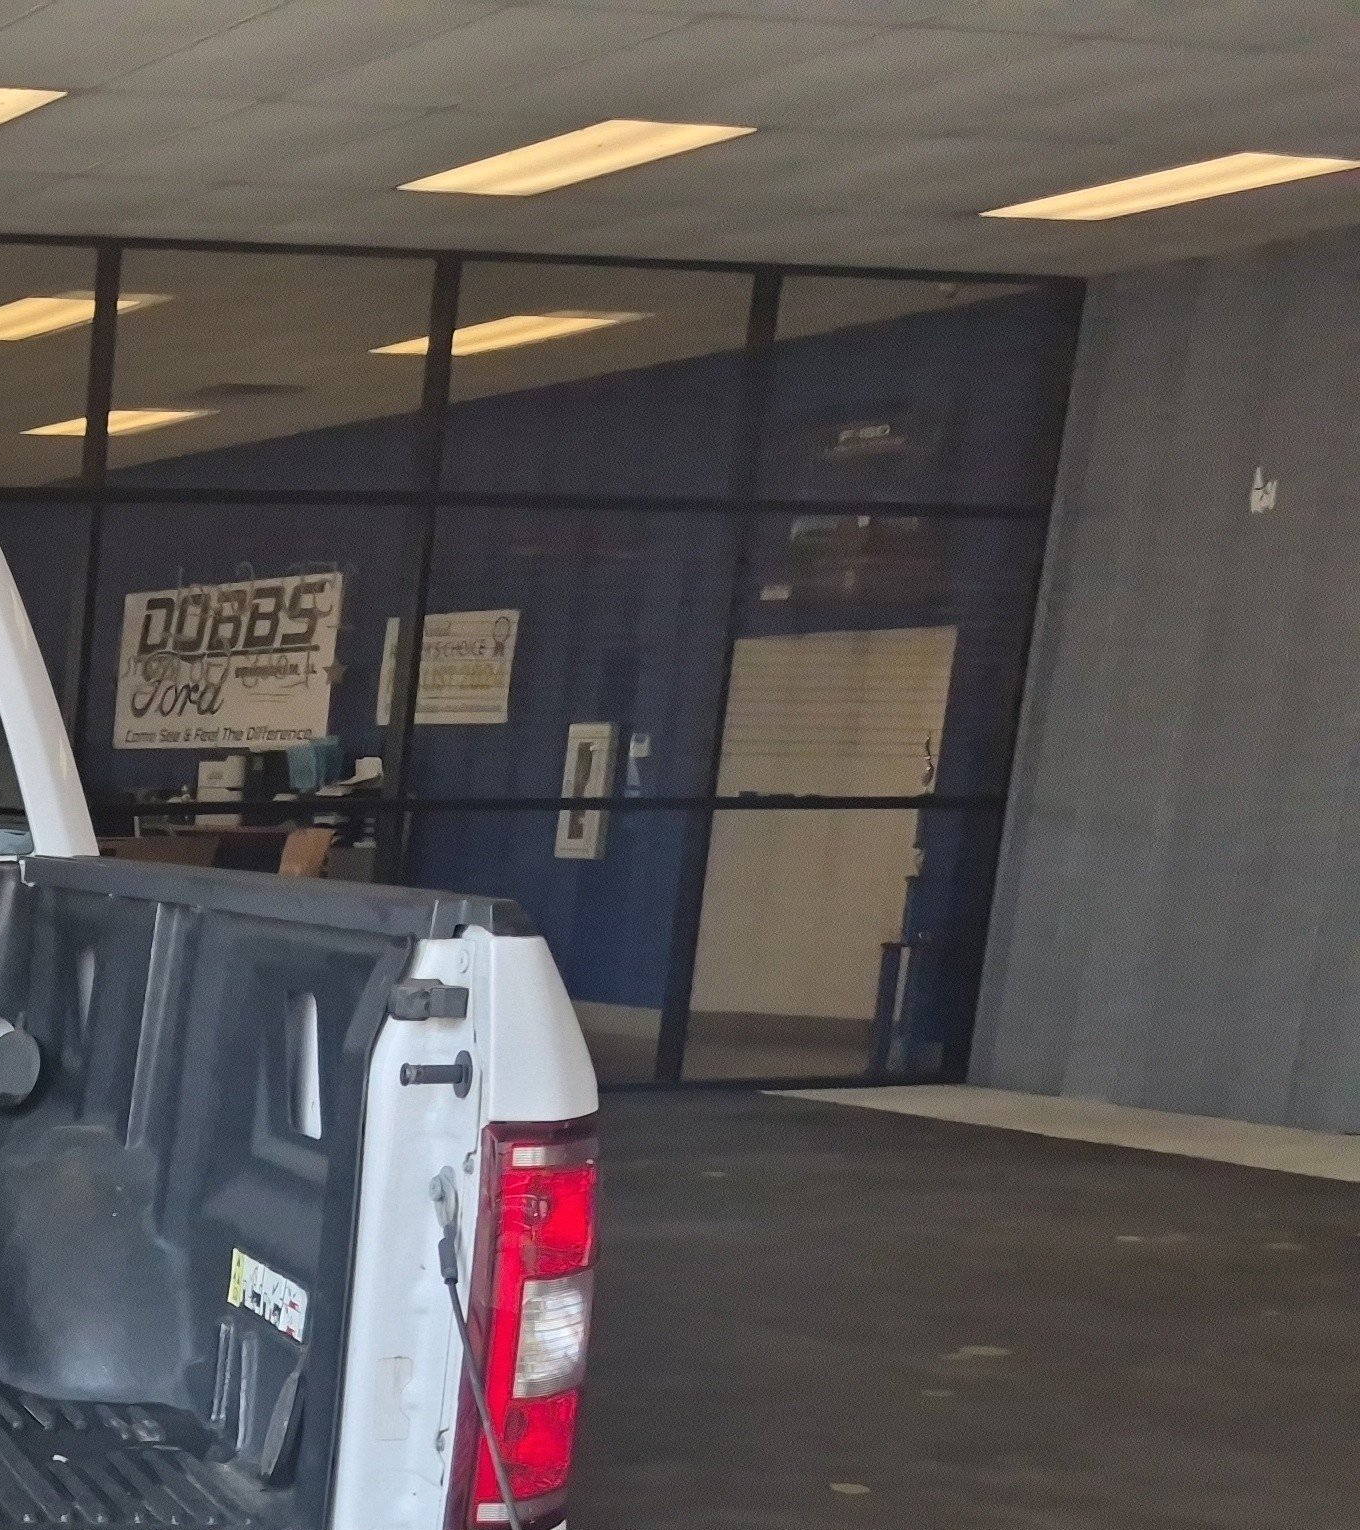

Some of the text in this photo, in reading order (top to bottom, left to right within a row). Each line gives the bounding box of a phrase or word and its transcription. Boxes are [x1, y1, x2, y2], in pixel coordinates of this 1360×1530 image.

[137, 579, 326, 655] DOBBS
[130, 655, 229, 718] Ford
[223, 727, 243, 742] The
